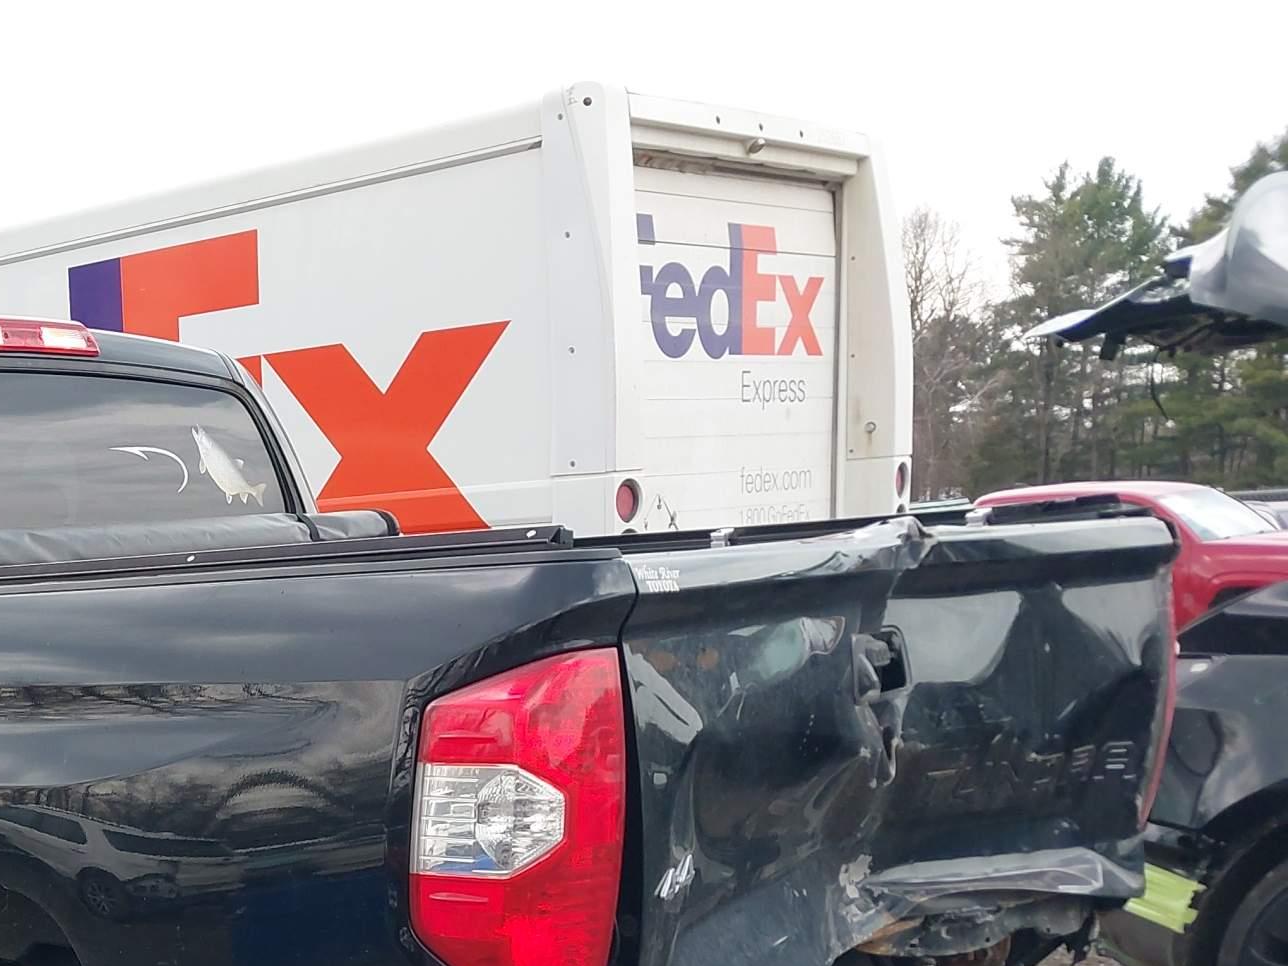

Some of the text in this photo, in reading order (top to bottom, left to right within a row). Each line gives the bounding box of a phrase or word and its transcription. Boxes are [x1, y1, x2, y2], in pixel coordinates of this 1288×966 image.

[741, 370, 806, 410] Express
[739, 464, 811, 494] fedex.com
[646, 580, 680, 592] TOYOTA
